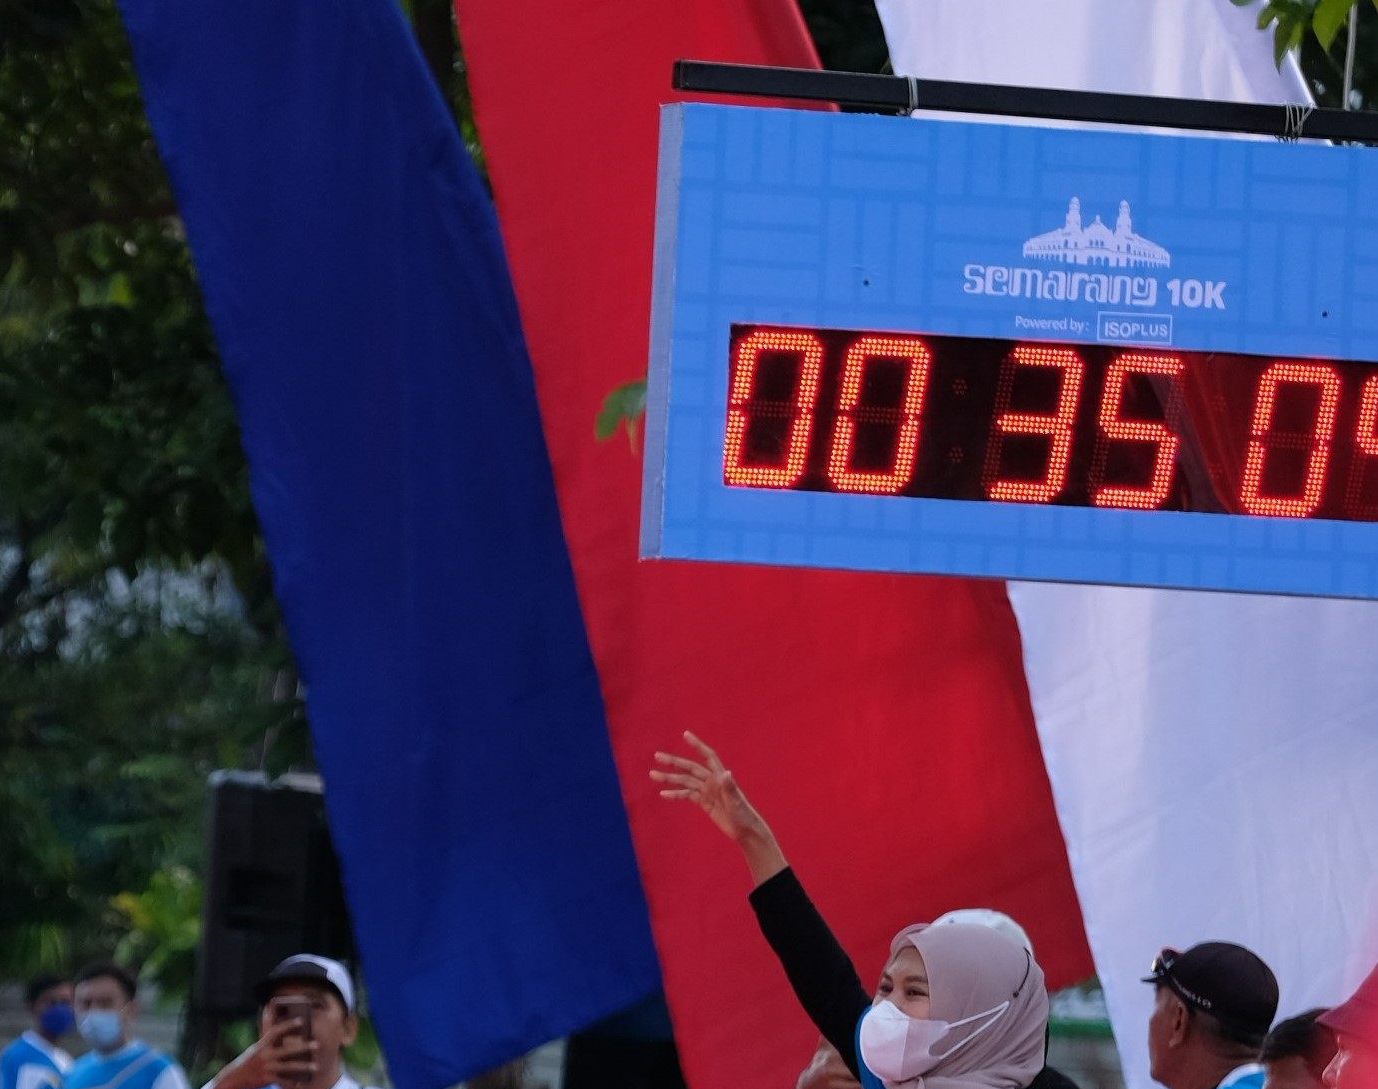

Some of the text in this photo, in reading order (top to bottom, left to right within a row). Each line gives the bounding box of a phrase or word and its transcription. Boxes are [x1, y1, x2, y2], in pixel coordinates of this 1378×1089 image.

[1167, 279, 1226, 309] 10K
[1015, 315, 1067, 330] Powered
[1104, 321, 1168, 338] ISOPLUS
[988, 346, 1184, 510] 35
[1240, 362, 1378, 518] 0
